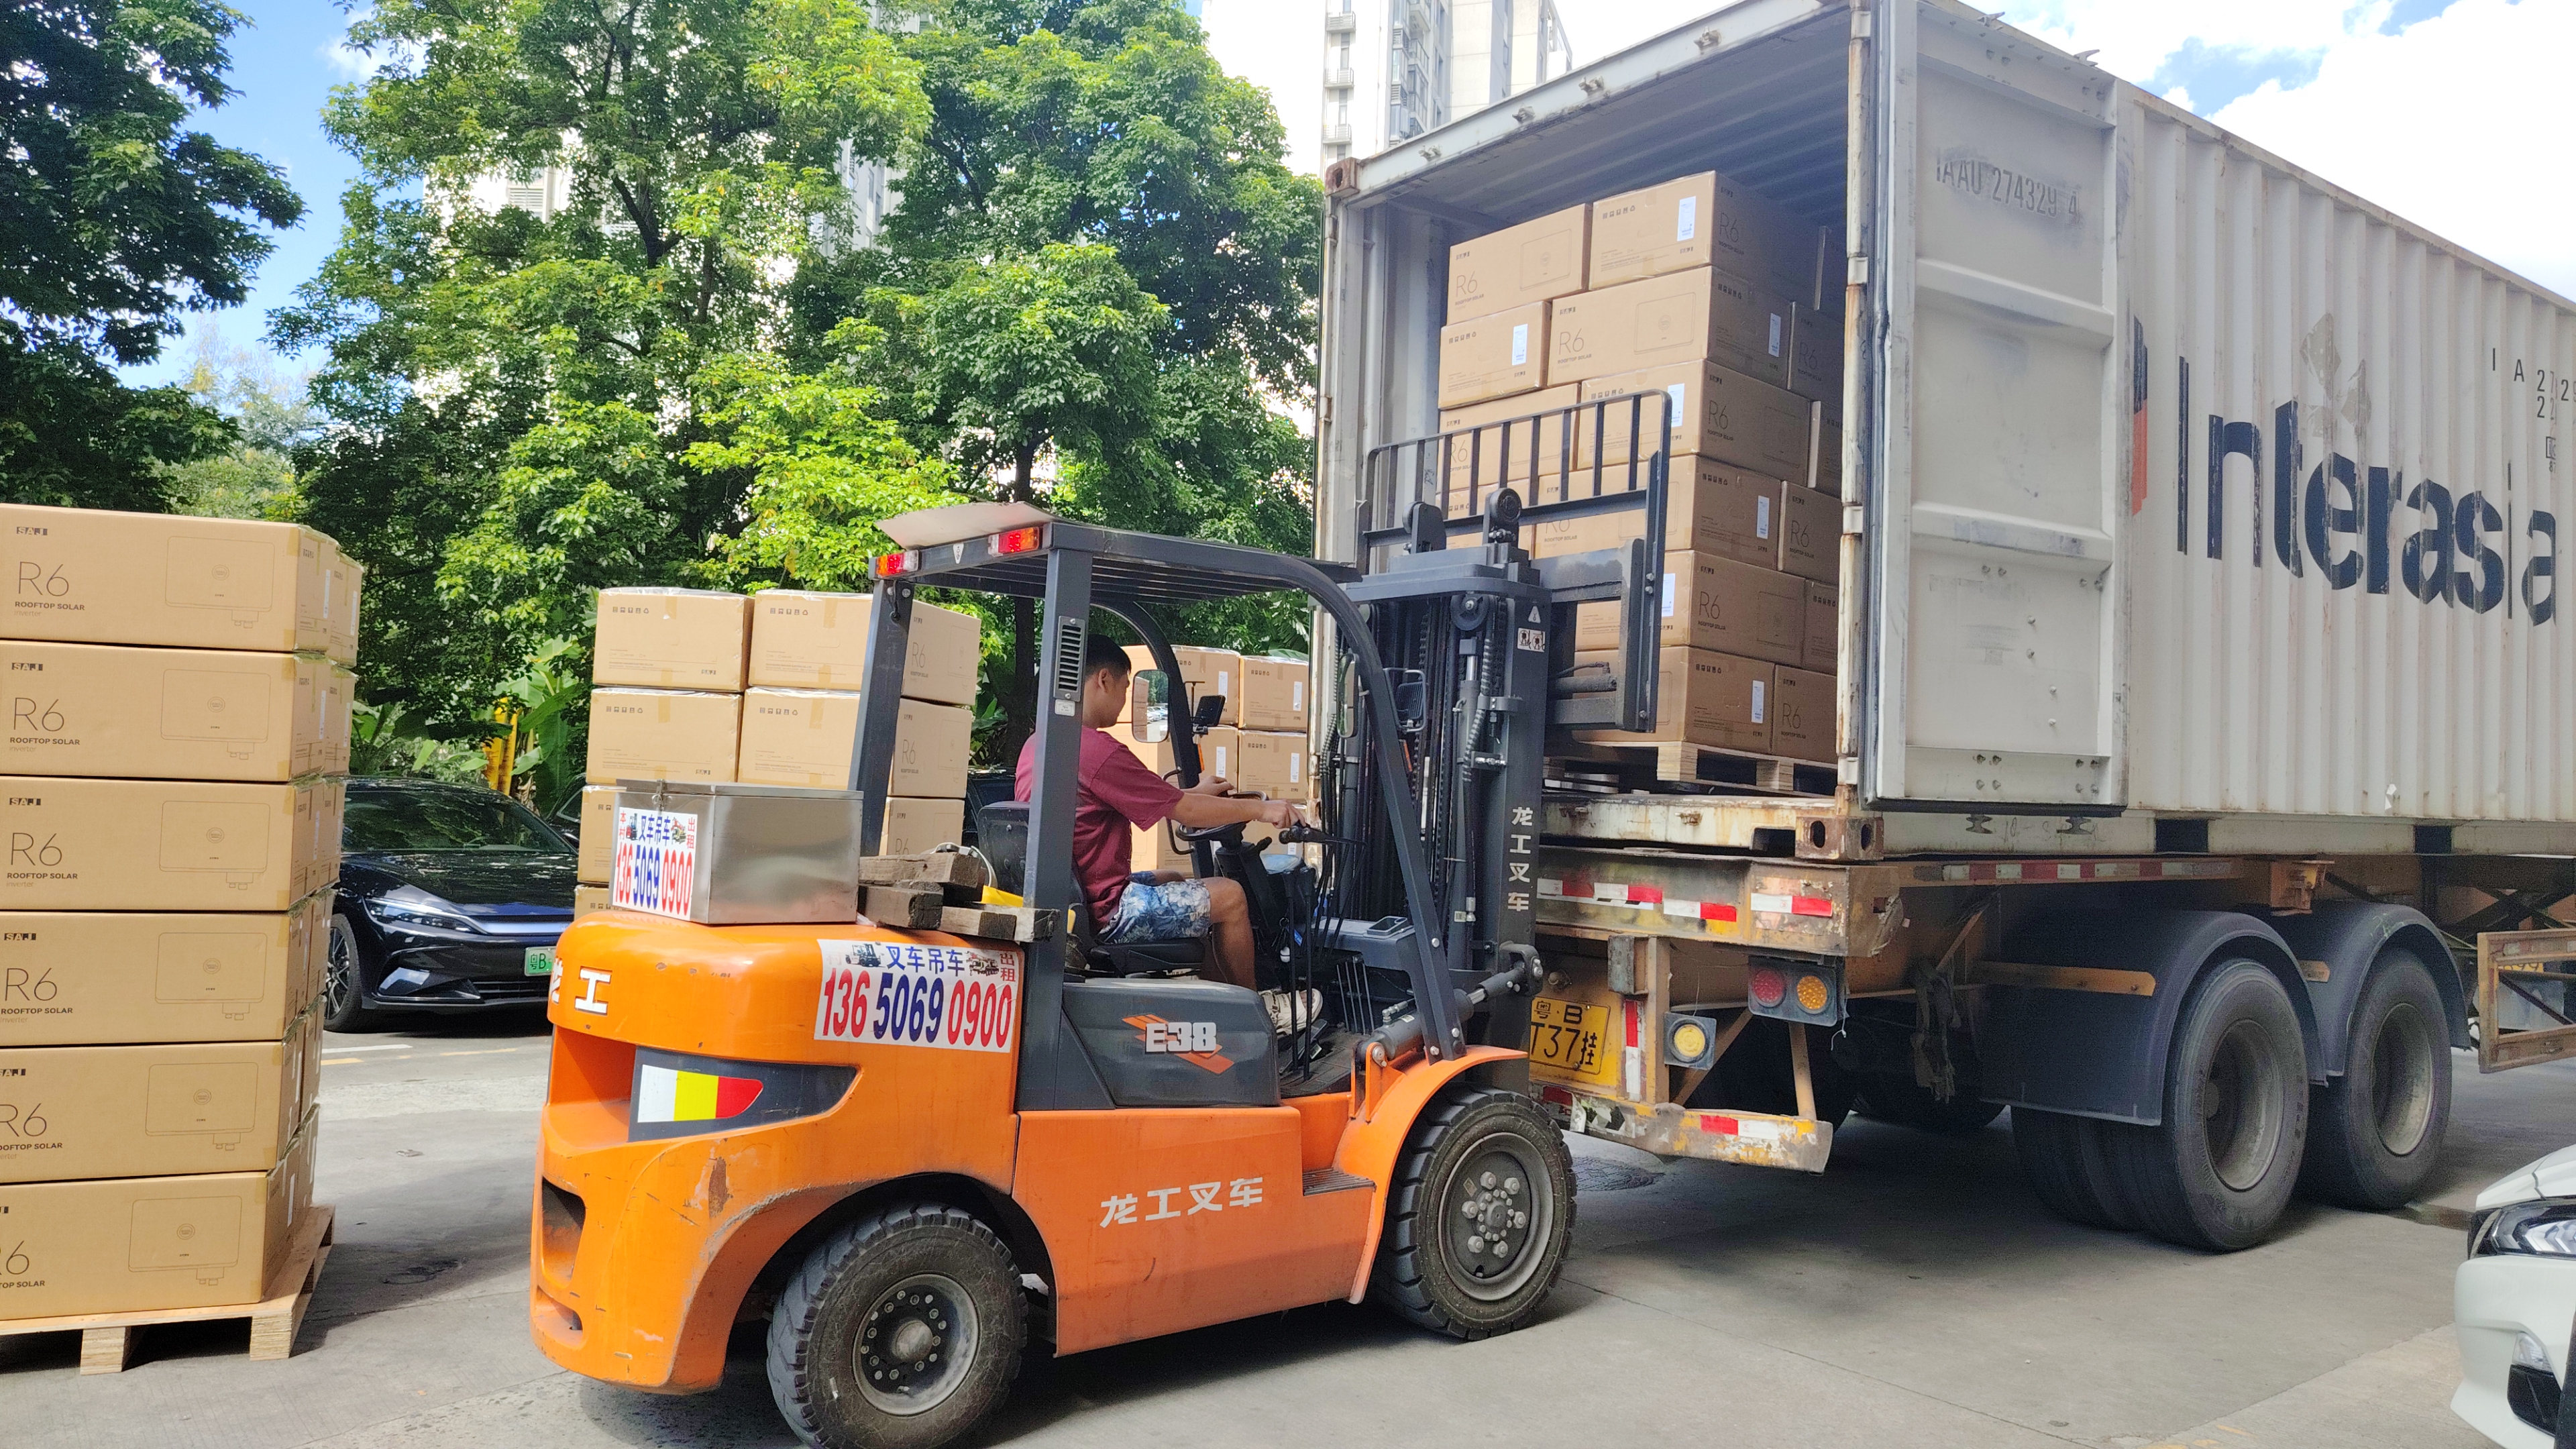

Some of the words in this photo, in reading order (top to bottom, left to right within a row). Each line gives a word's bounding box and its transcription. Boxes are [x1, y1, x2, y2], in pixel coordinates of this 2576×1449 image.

[1992, 166, 2057, 217] 274329
[1456, 270, 1478, 298] R6
[1558, 328, 1585, 356] R6
[1708, 400, 1729, 430] R6
[2178, 354, 2557, 627] Interasia
[16, 526, 48, 536] SAJ
[1790, 520, 1809, 547] R6
[18, 561, 70, 597] R6
[14, 601, 56, 609] ROOFTOP
[1699, 591, 1721, 620] R6
[11, 662, 44, 672] SAJ
[912, 641, 926, 668] R6
[13, 697, 65, 732] R6
[1782, 702, 1801, 729] R6
[9, 737, 51, 745] ROOFTOP
[902, 739, 916, 765] R6
[9, 797, 42, 806] SAJ
[619, 810, 627, 840] 本村
[639, 814, 671, 847] 叉车吊车
[686, 816, 696, 850] 出租
[11, 833, 62, 867] R6
[1507, 806, 1534, 912] 龙工叉车
[614, 841, 633, 905] 136
[633, 844, 660, 910] 5069
[661, 848, 692, 916] 0900
[4, 932, 36, 941] SAJ
[885, 945, 965, 977] 叉车吊车
[1000, 952, 1016, 983] 出租
[5, 967, 57, 1002] R6
[822, 967, 871, 1038] 136
[873, 972, 945, 1044] 5069
[947, 979, 1012, 1049] 0900
[1146, 1022, 1217, 1053] E38
[0, 1103, 47, 1137] R6
[1099, 1177, 1263, 1228] 龙工叉车
[16, 1280, 46, 1288] SOLAR
